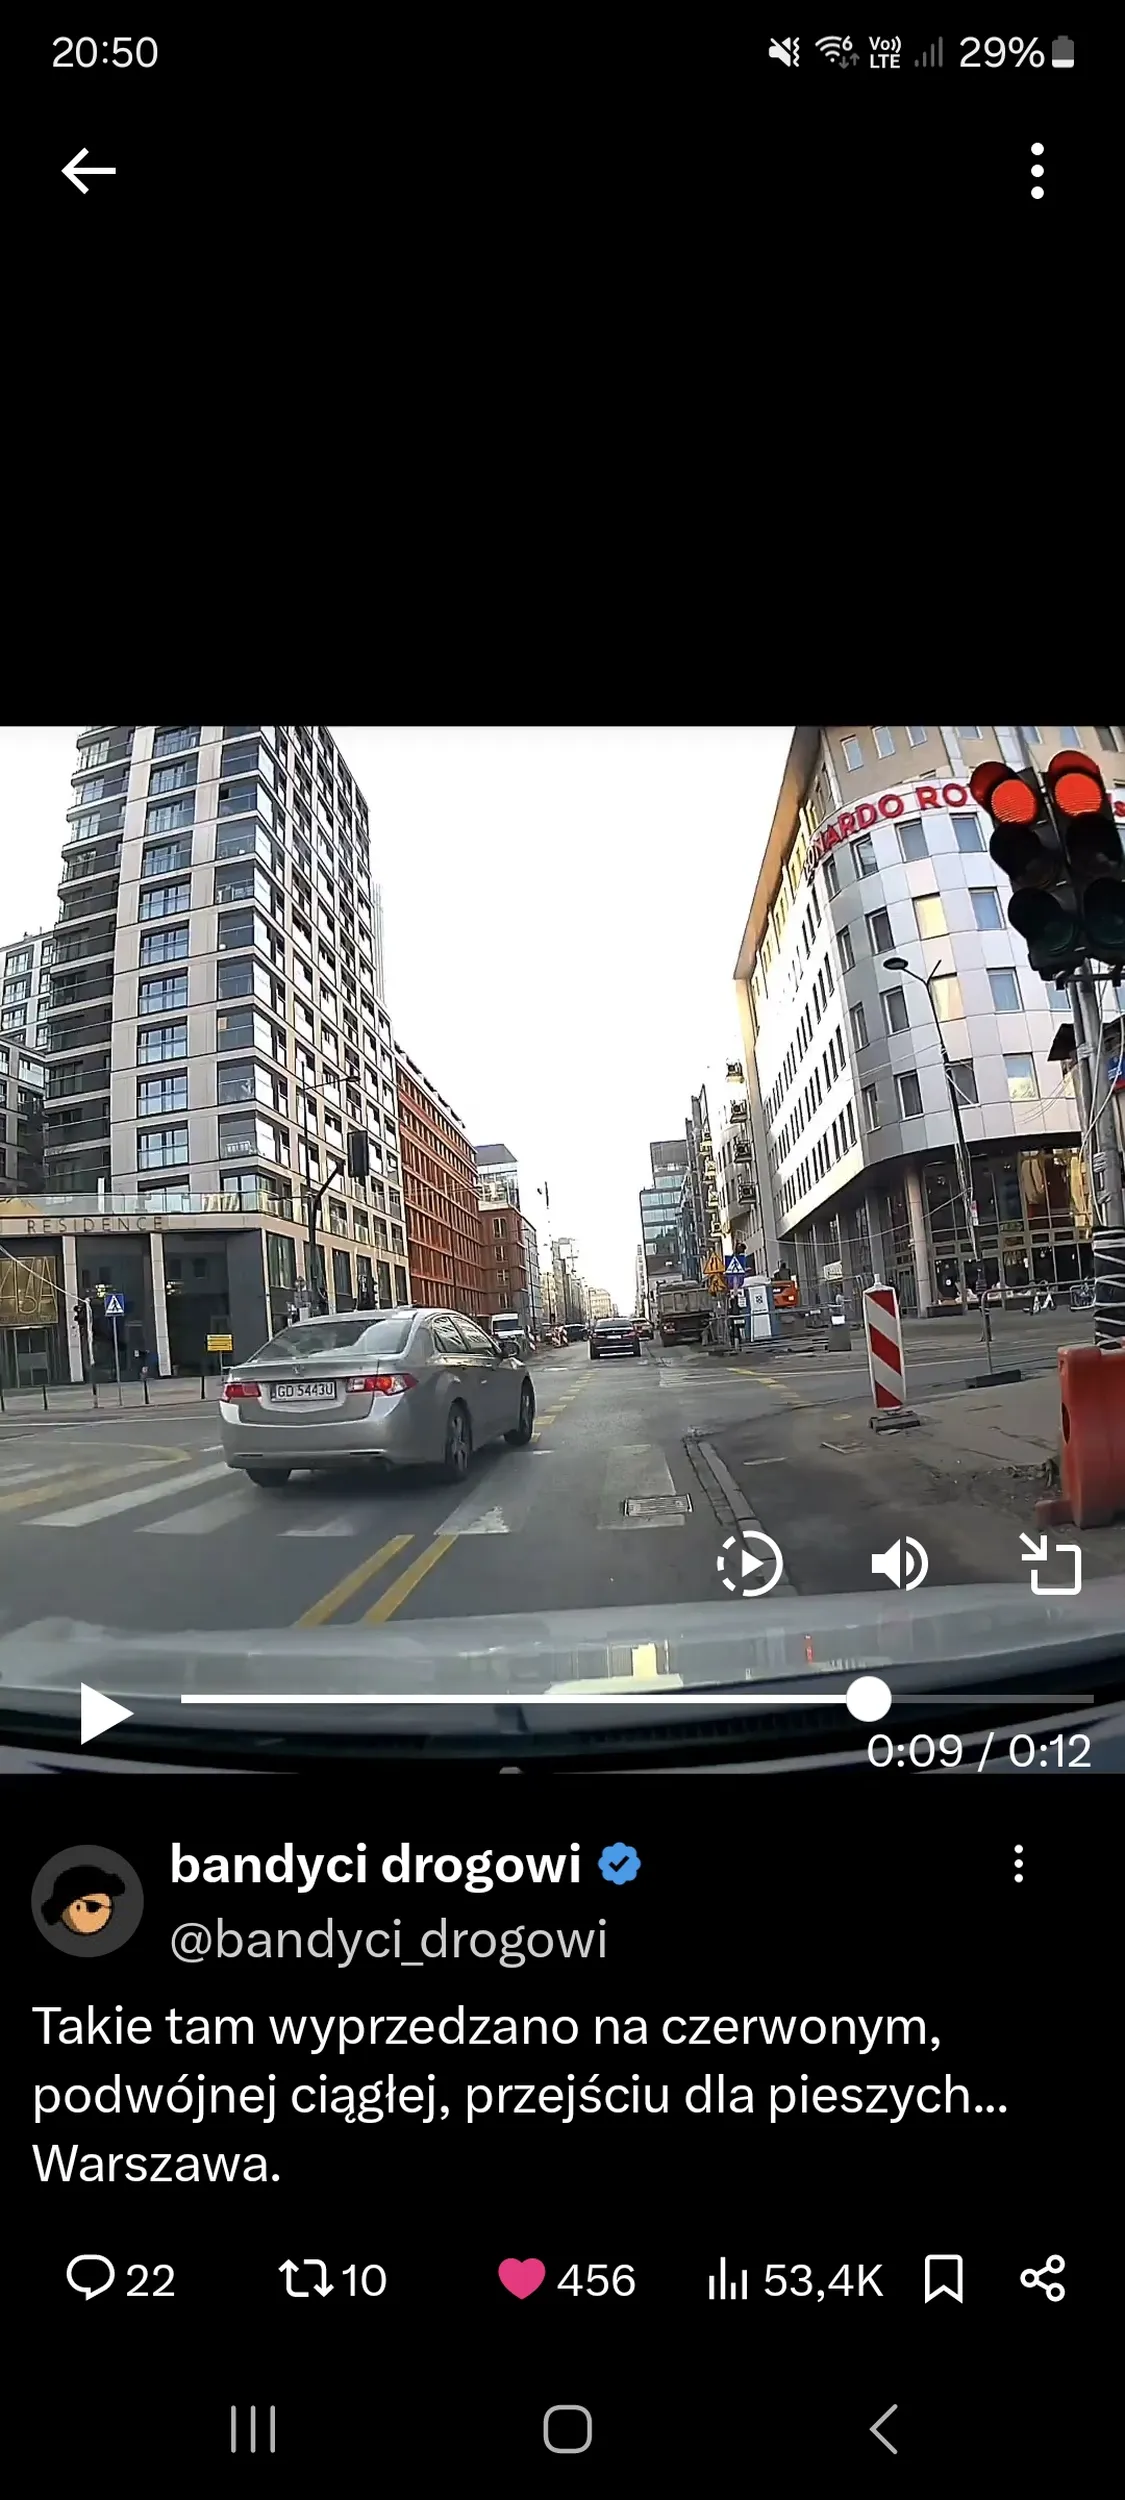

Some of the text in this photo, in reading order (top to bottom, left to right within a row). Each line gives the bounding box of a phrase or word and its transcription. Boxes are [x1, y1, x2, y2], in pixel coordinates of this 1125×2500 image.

[915, 783, 968, 811] RO
[27, 1216, 163, 1234] RESIDENCE
[277, 1382, 334, 1398] GD 5443U
